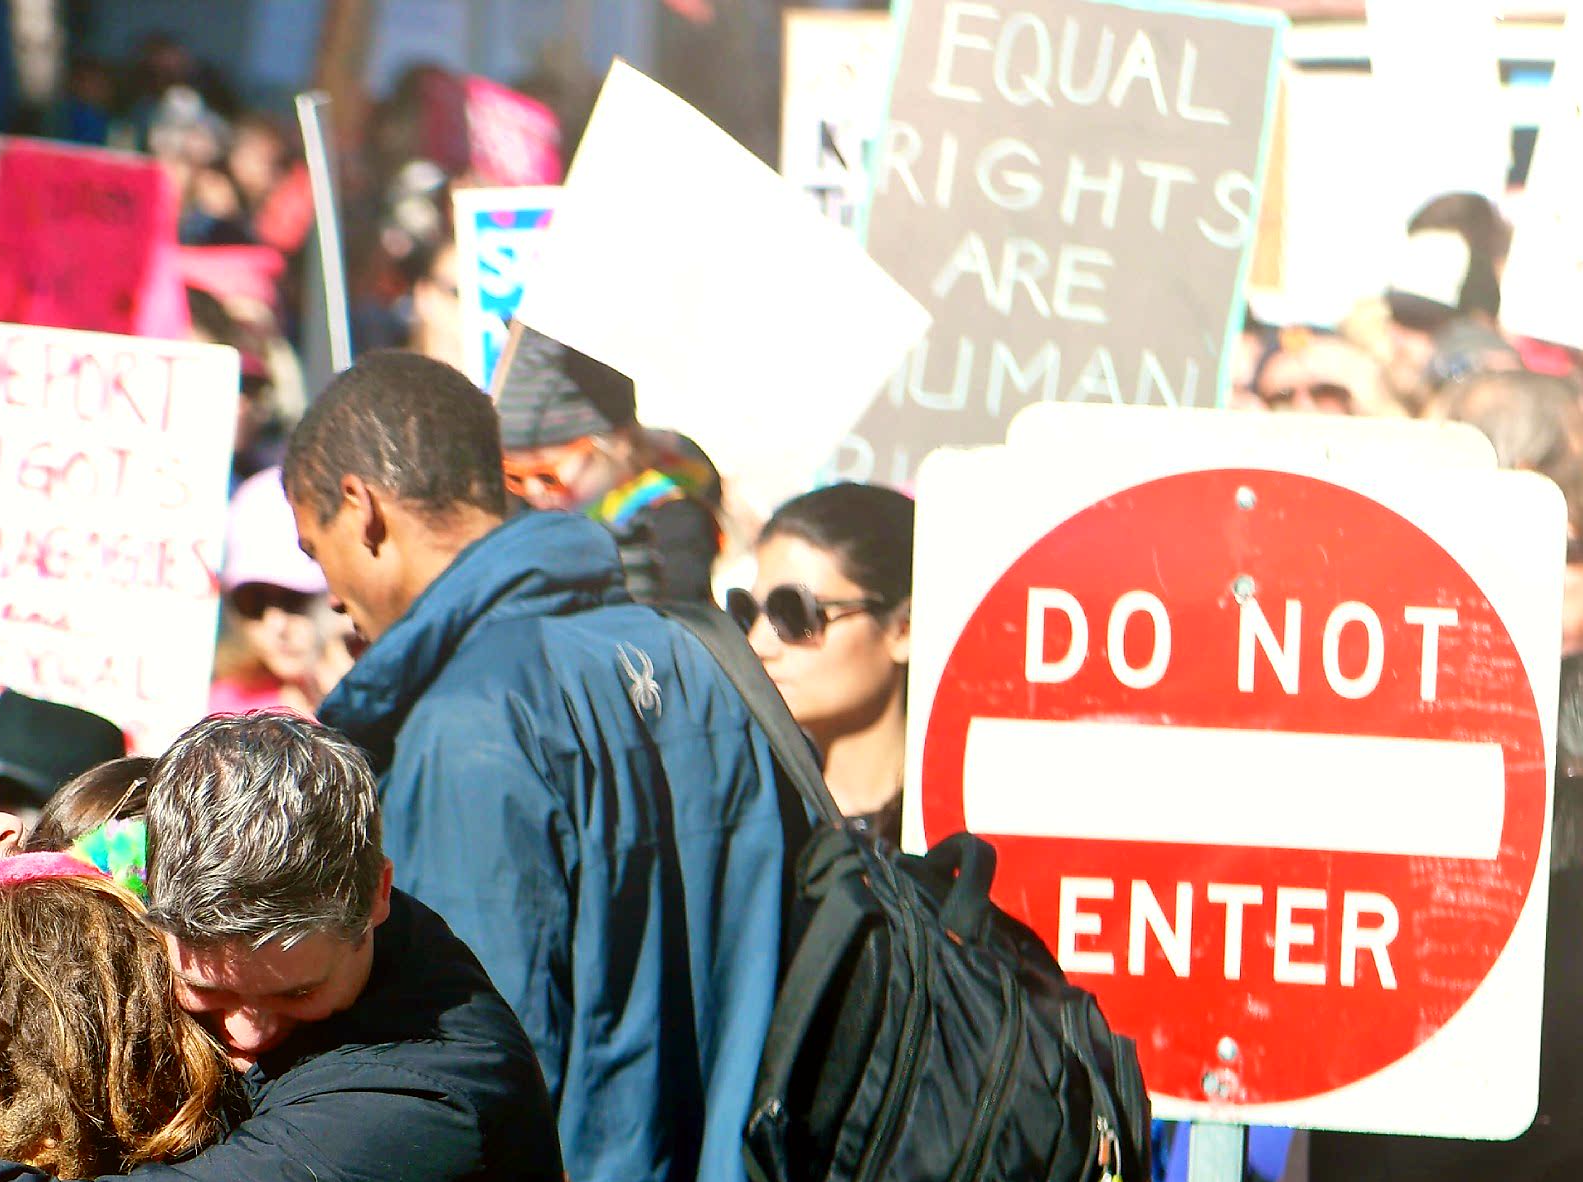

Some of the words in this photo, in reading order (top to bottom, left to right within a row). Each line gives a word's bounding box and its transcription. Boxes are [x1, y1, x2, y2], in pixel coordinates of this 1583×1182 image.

[928, 4, 1231, 126] EQUAL
[878, 118, 1258, 250] RIGHTS
[930, 230, 1115, 323] ARE
[1025, 587, 1172, 689] DO
[1237, 590, 1459, 702] NOT
[1057, 876, 1400, 990] ENTER
